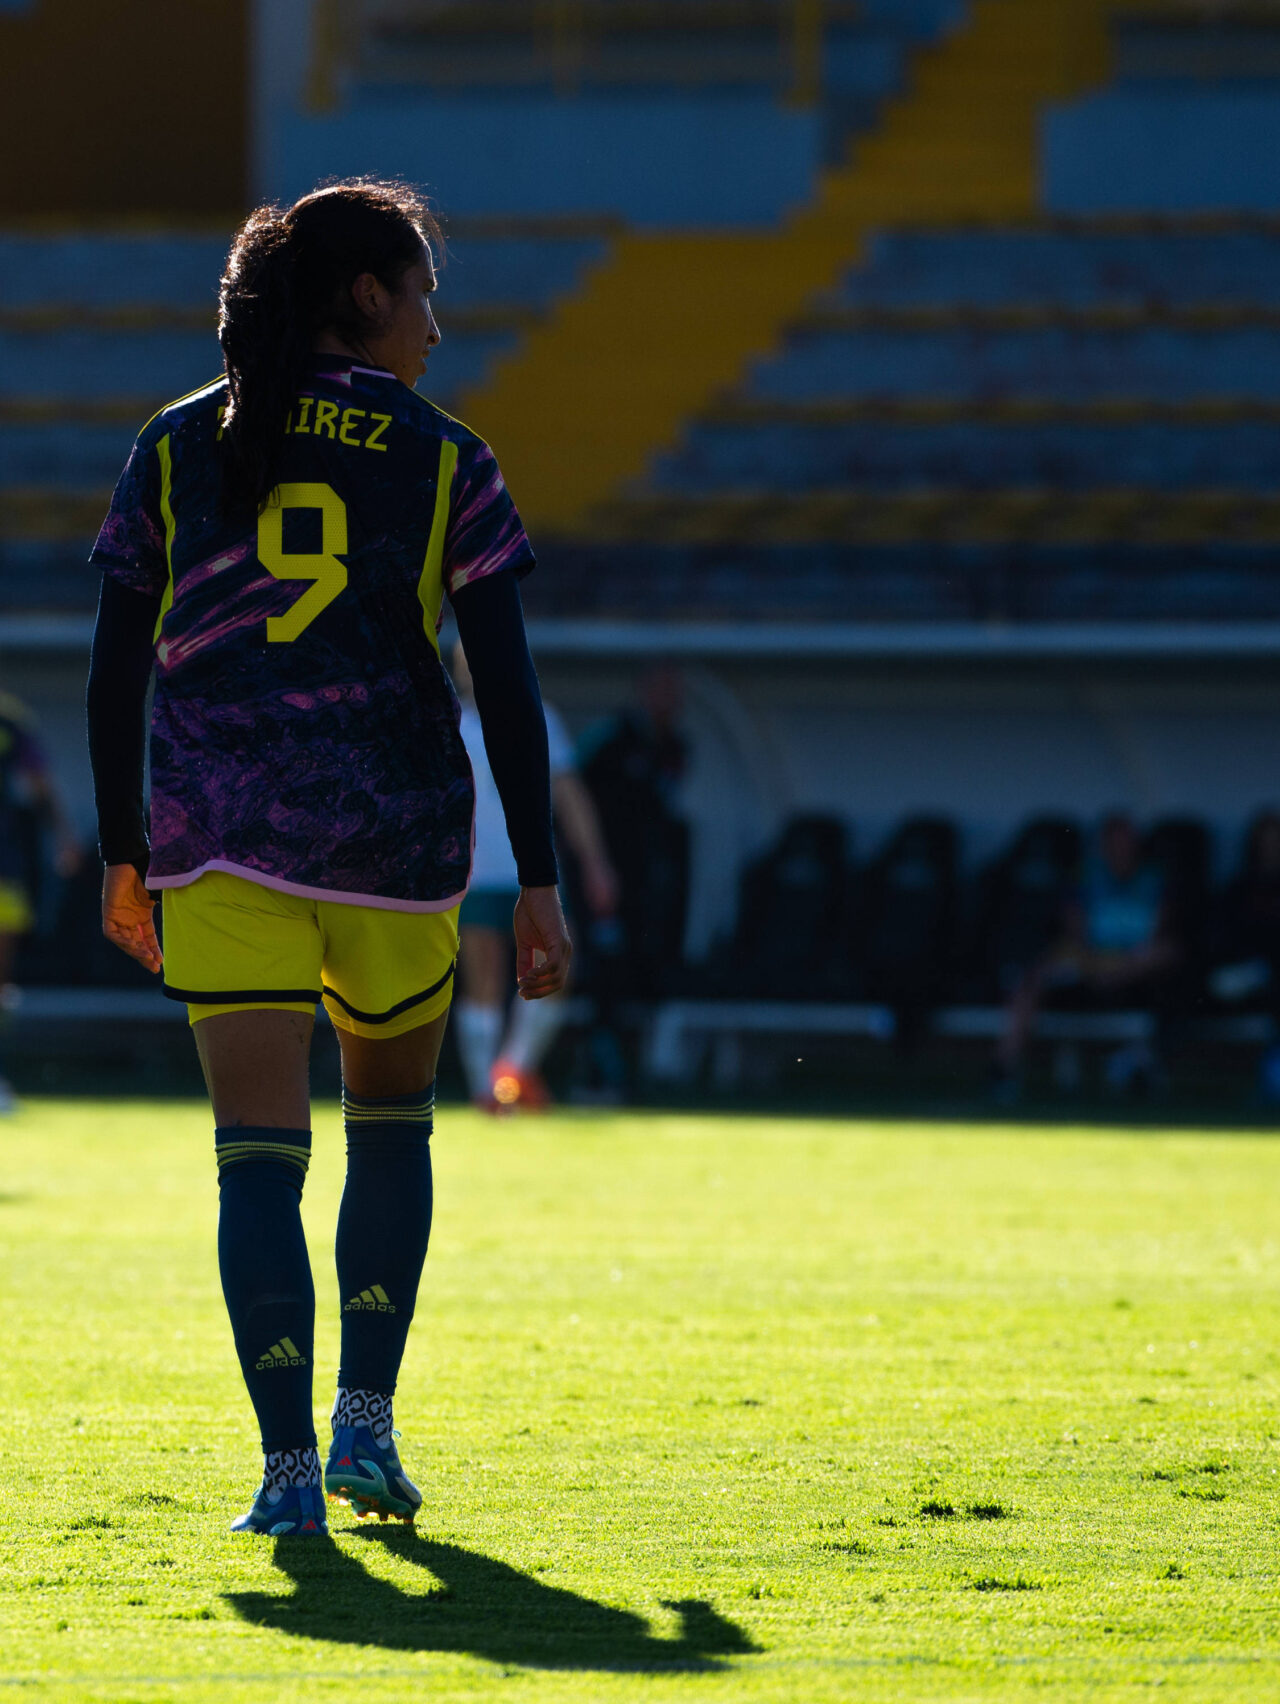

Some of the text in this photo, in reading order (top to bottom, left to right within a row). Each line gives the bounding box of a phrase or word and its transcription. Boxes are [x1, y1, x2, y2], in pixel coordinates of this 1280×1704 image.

[216, 397, 393, 453] IREZ
[257, 481, 349, 643] 9
[343, 1300, 397, 1314] adidas
[255, 1355, 307, 1371] adidas
